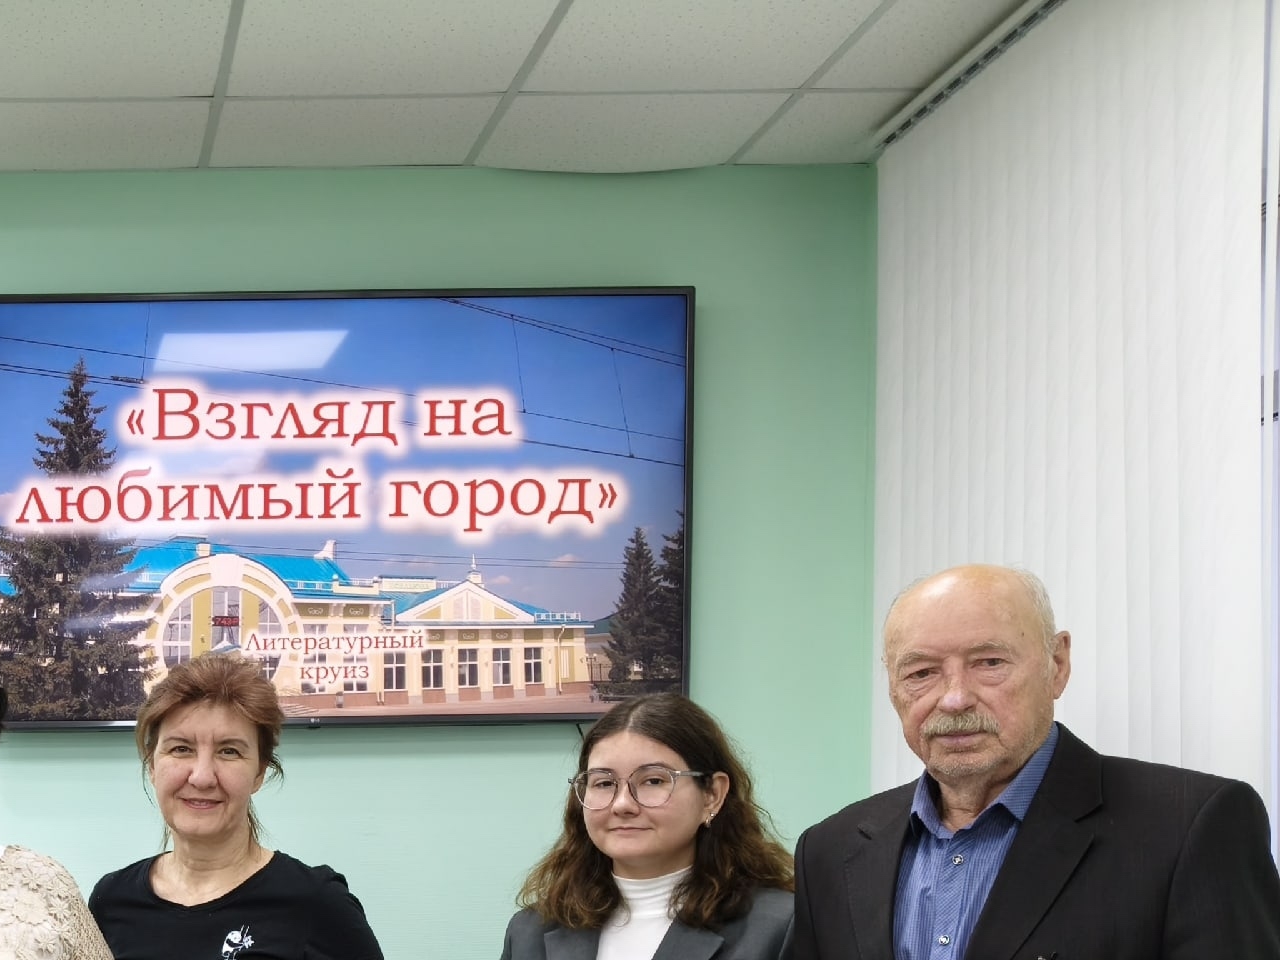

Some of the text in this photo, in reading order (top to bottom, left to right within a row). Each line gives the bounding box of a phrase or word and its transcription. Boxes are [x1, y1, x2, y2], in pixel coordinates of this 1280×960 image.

[126, 388, 510, 447] «Взгляд на
[16, 467, 617, 532] любимый город»
[247, 631, 424, 654] Литературный
[300, 665, 369, 683] круиз
